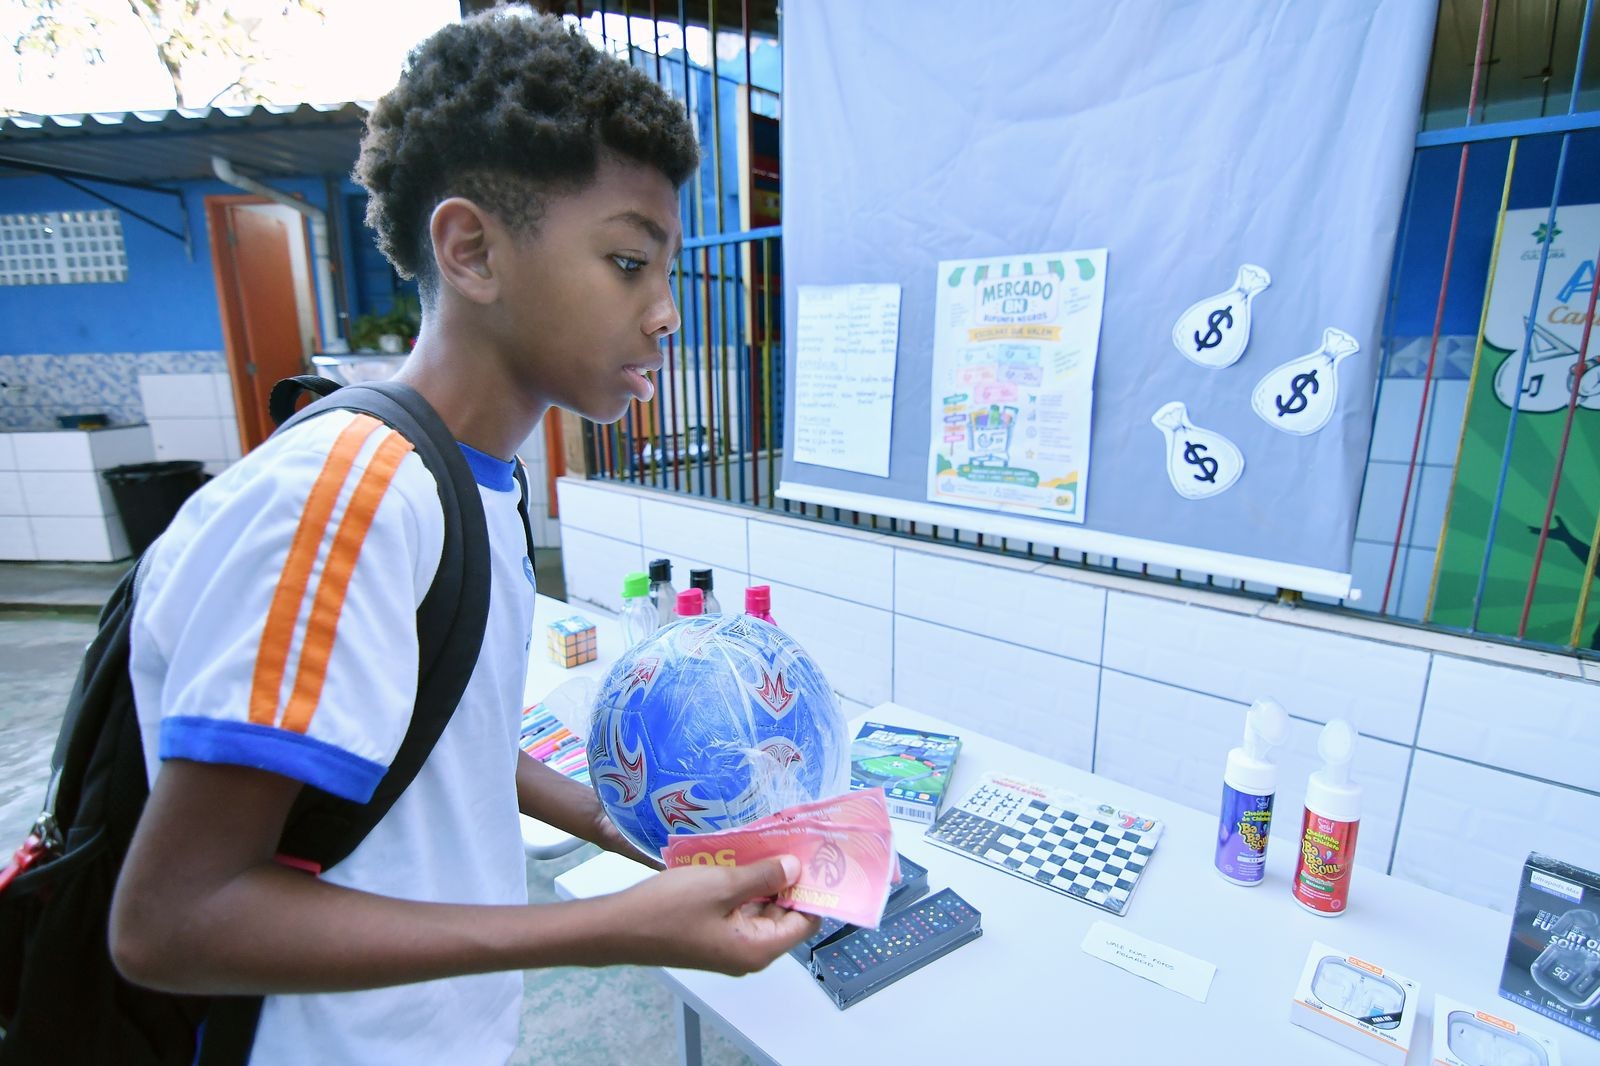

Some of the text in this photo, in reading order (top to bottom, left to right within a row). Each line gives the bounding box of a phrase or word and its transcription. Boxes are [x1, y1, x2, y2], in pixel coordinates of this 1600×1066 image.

[982, 280, 1053, 305] MERCADO
[1552, 966, 1570, 981] 90
[1506, 993, 1528, 1007] TRUE
[1531, 1003, 1576, 1027] WIRELESS
